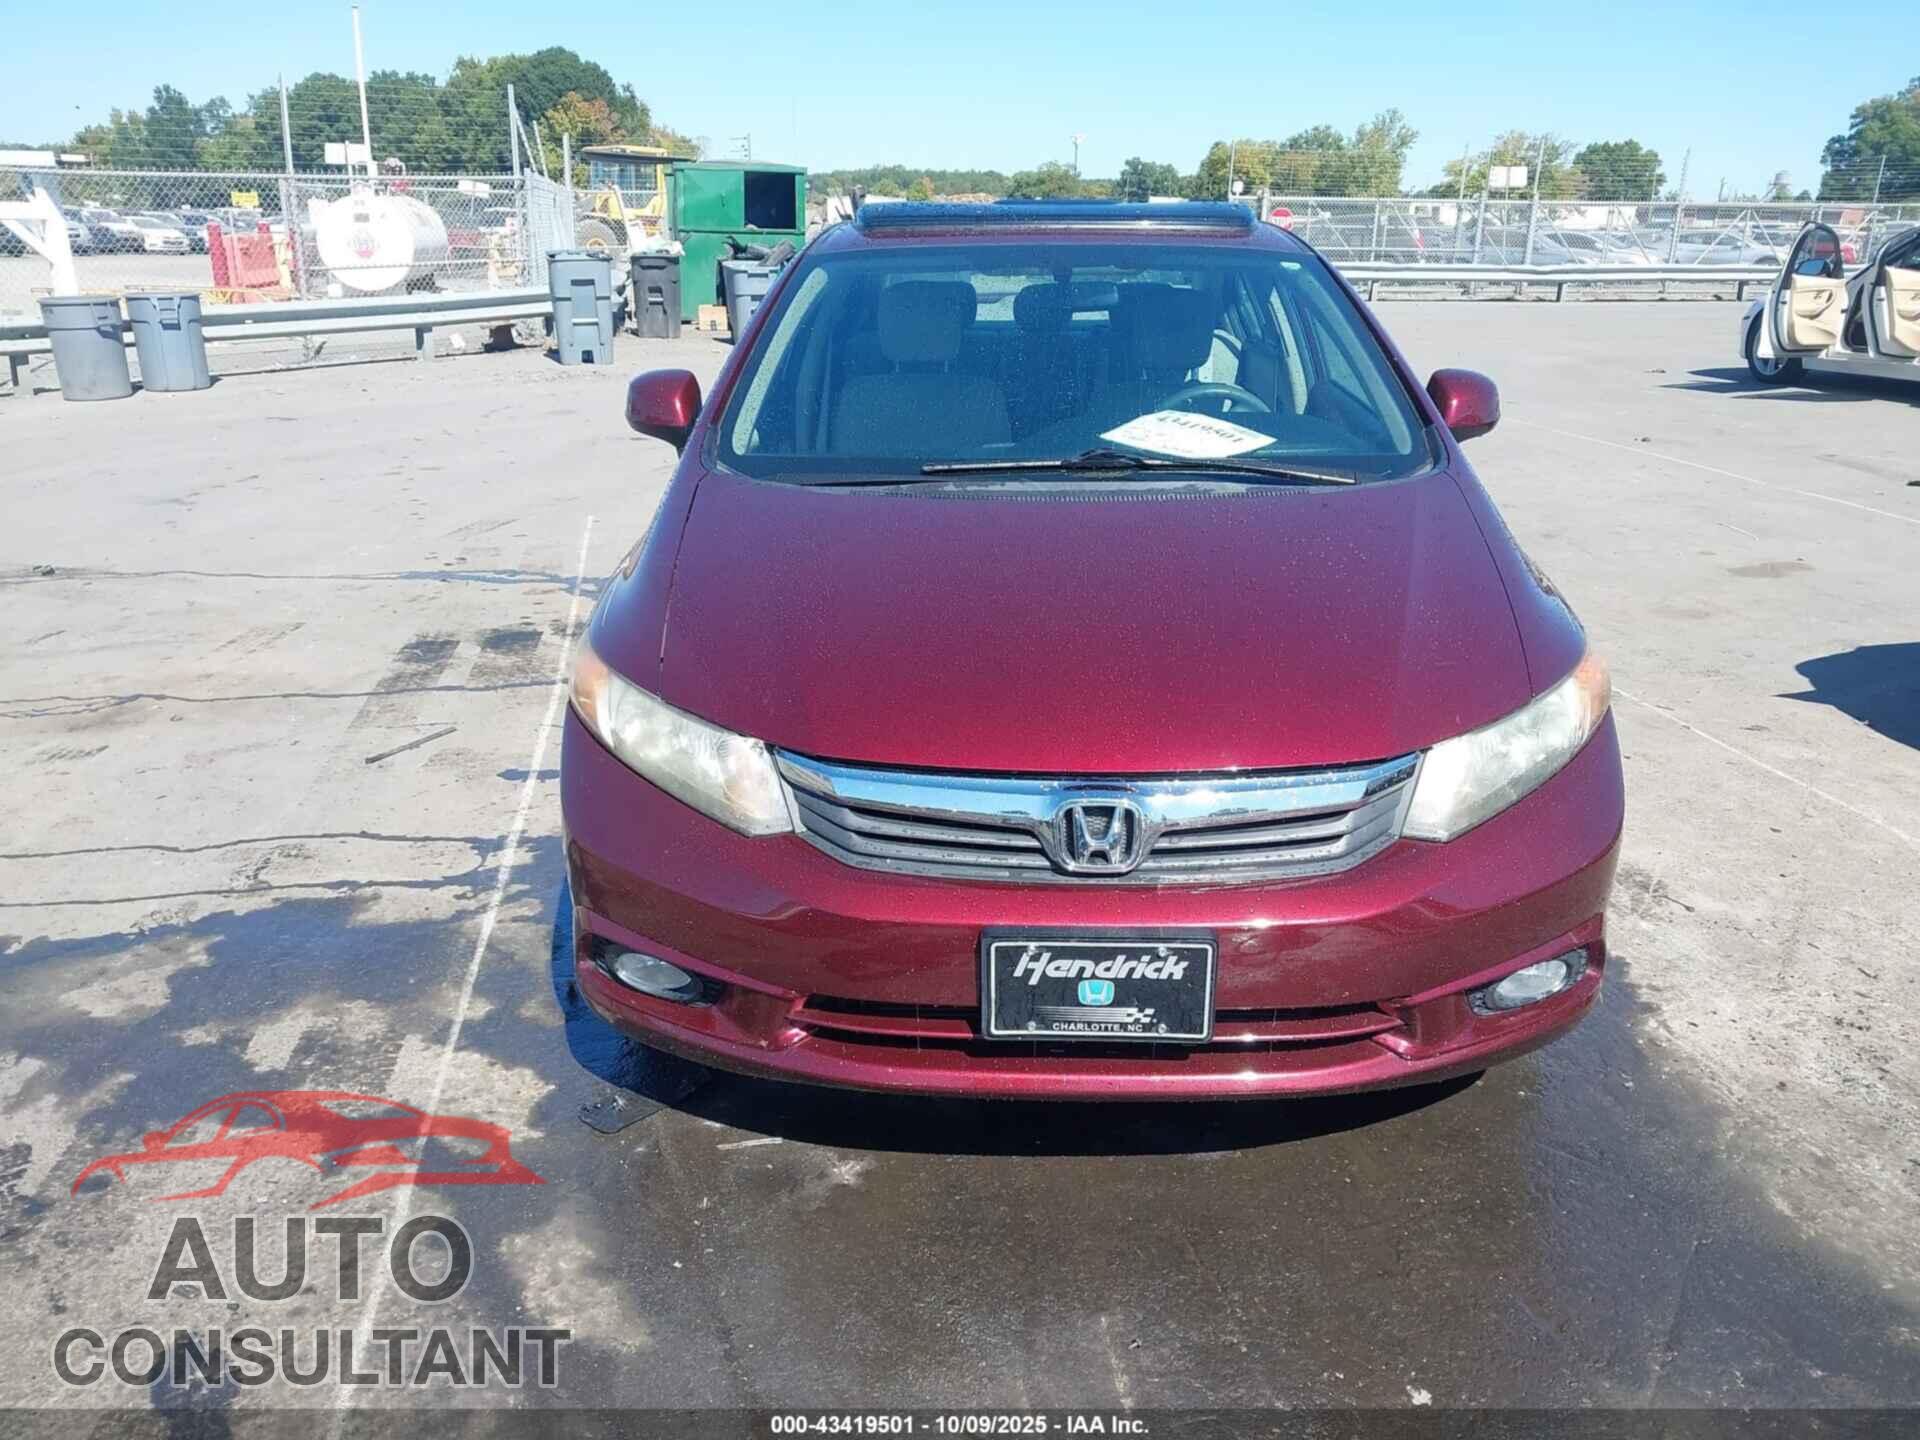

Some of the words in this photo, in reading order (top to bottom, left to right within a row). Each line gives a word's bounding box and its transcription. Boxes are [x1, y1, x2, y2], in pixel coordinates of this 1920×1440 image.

[1013, 951, 1189, 986] Hendrick
[1052, 1022, 1124, 1033] CHARLOTTE,
[1127, 1023, 1143, 1033] NC
